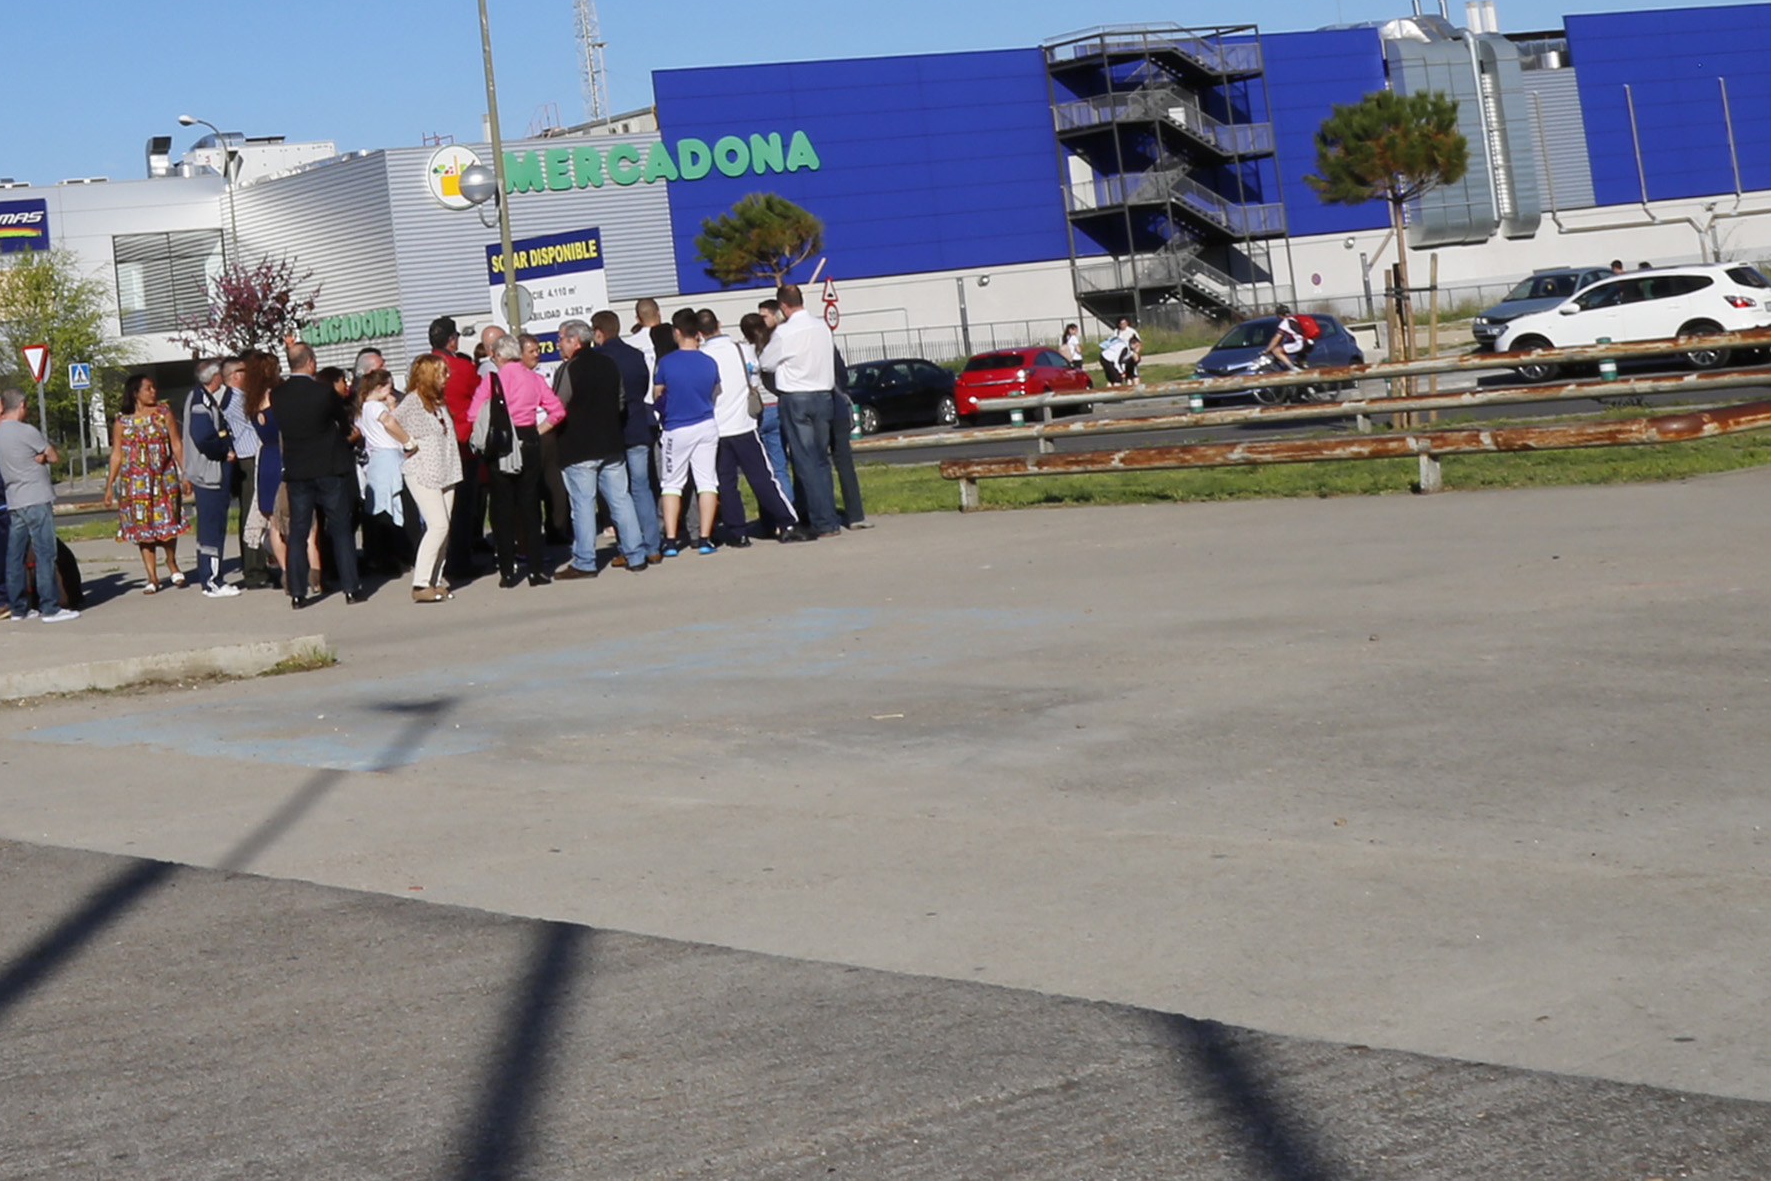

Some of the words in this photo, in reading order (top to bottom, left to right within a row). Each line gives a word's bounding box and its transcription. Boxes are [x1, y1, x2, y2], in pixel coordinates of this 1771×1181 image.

[502, 130, 820, 194] MERCADONA
[491, 250, 529, 273] SOAR
[529, 239, 598, 267] DISPONIBLE
